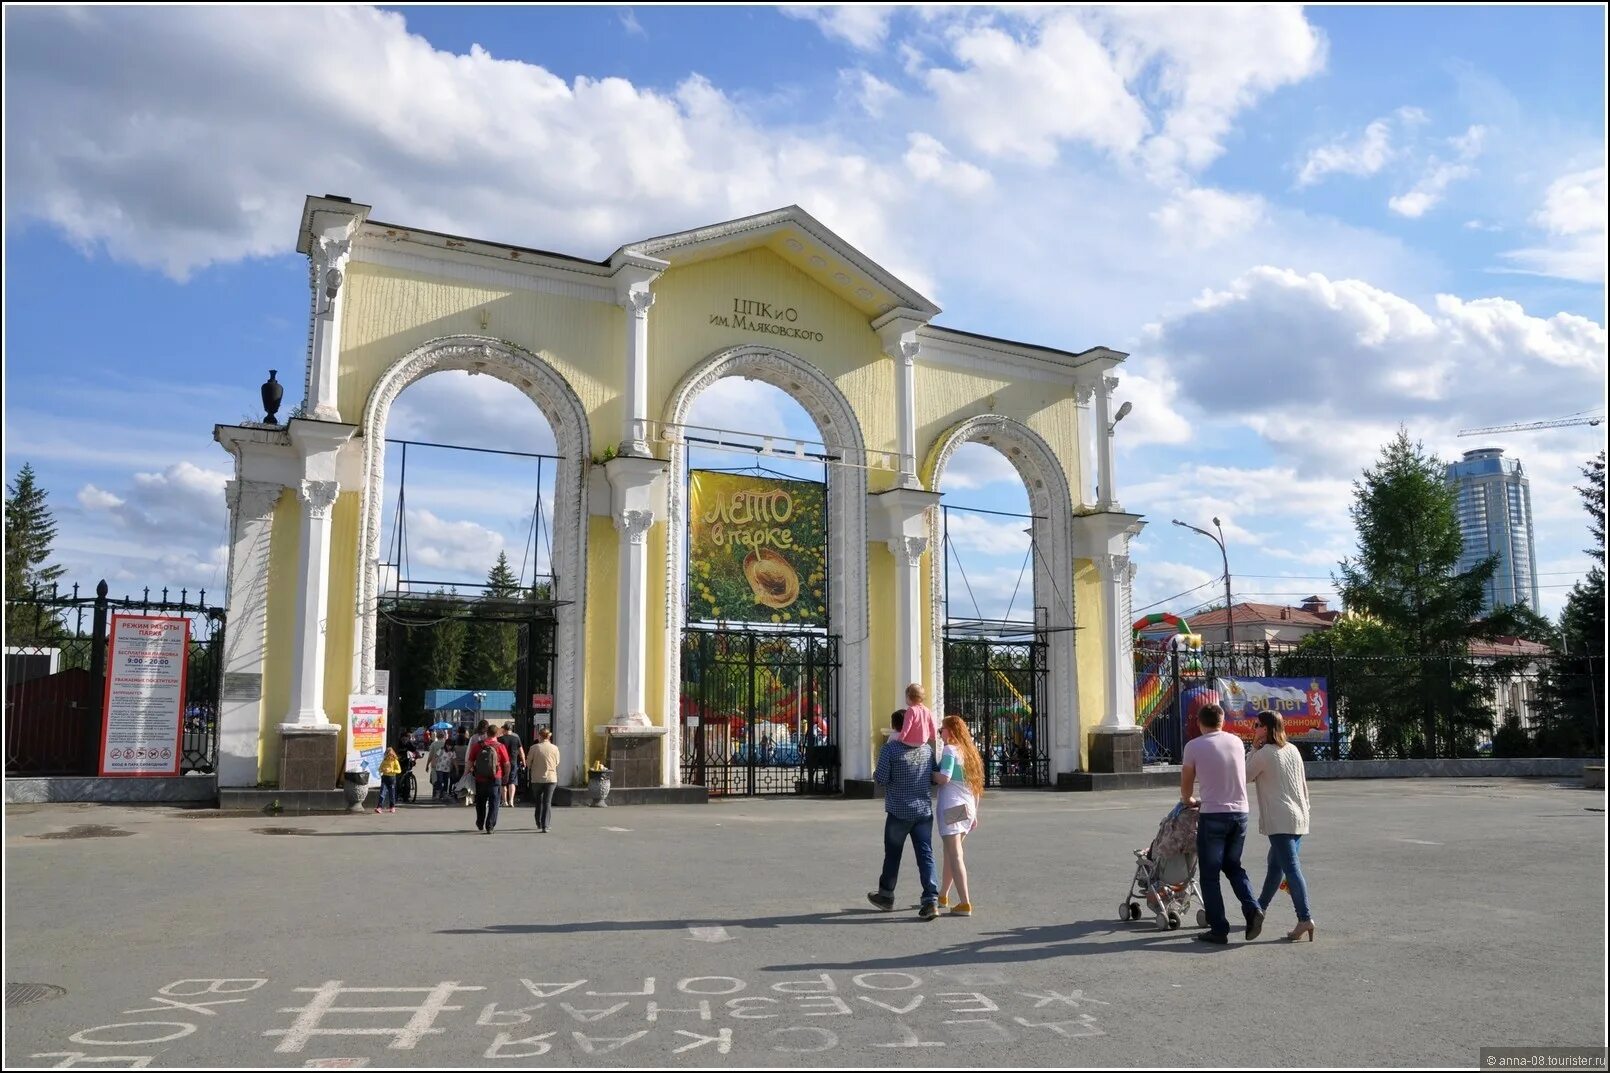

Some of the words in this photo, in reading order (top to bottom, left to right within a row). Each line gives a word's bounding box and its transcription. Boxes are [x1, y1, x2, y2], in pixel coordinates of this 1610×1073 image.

[150, 623, 180, 631] РАБОТЫ
[1251, 696, 1269, 711] 90
[1275, 697, 1301, 711] лет
